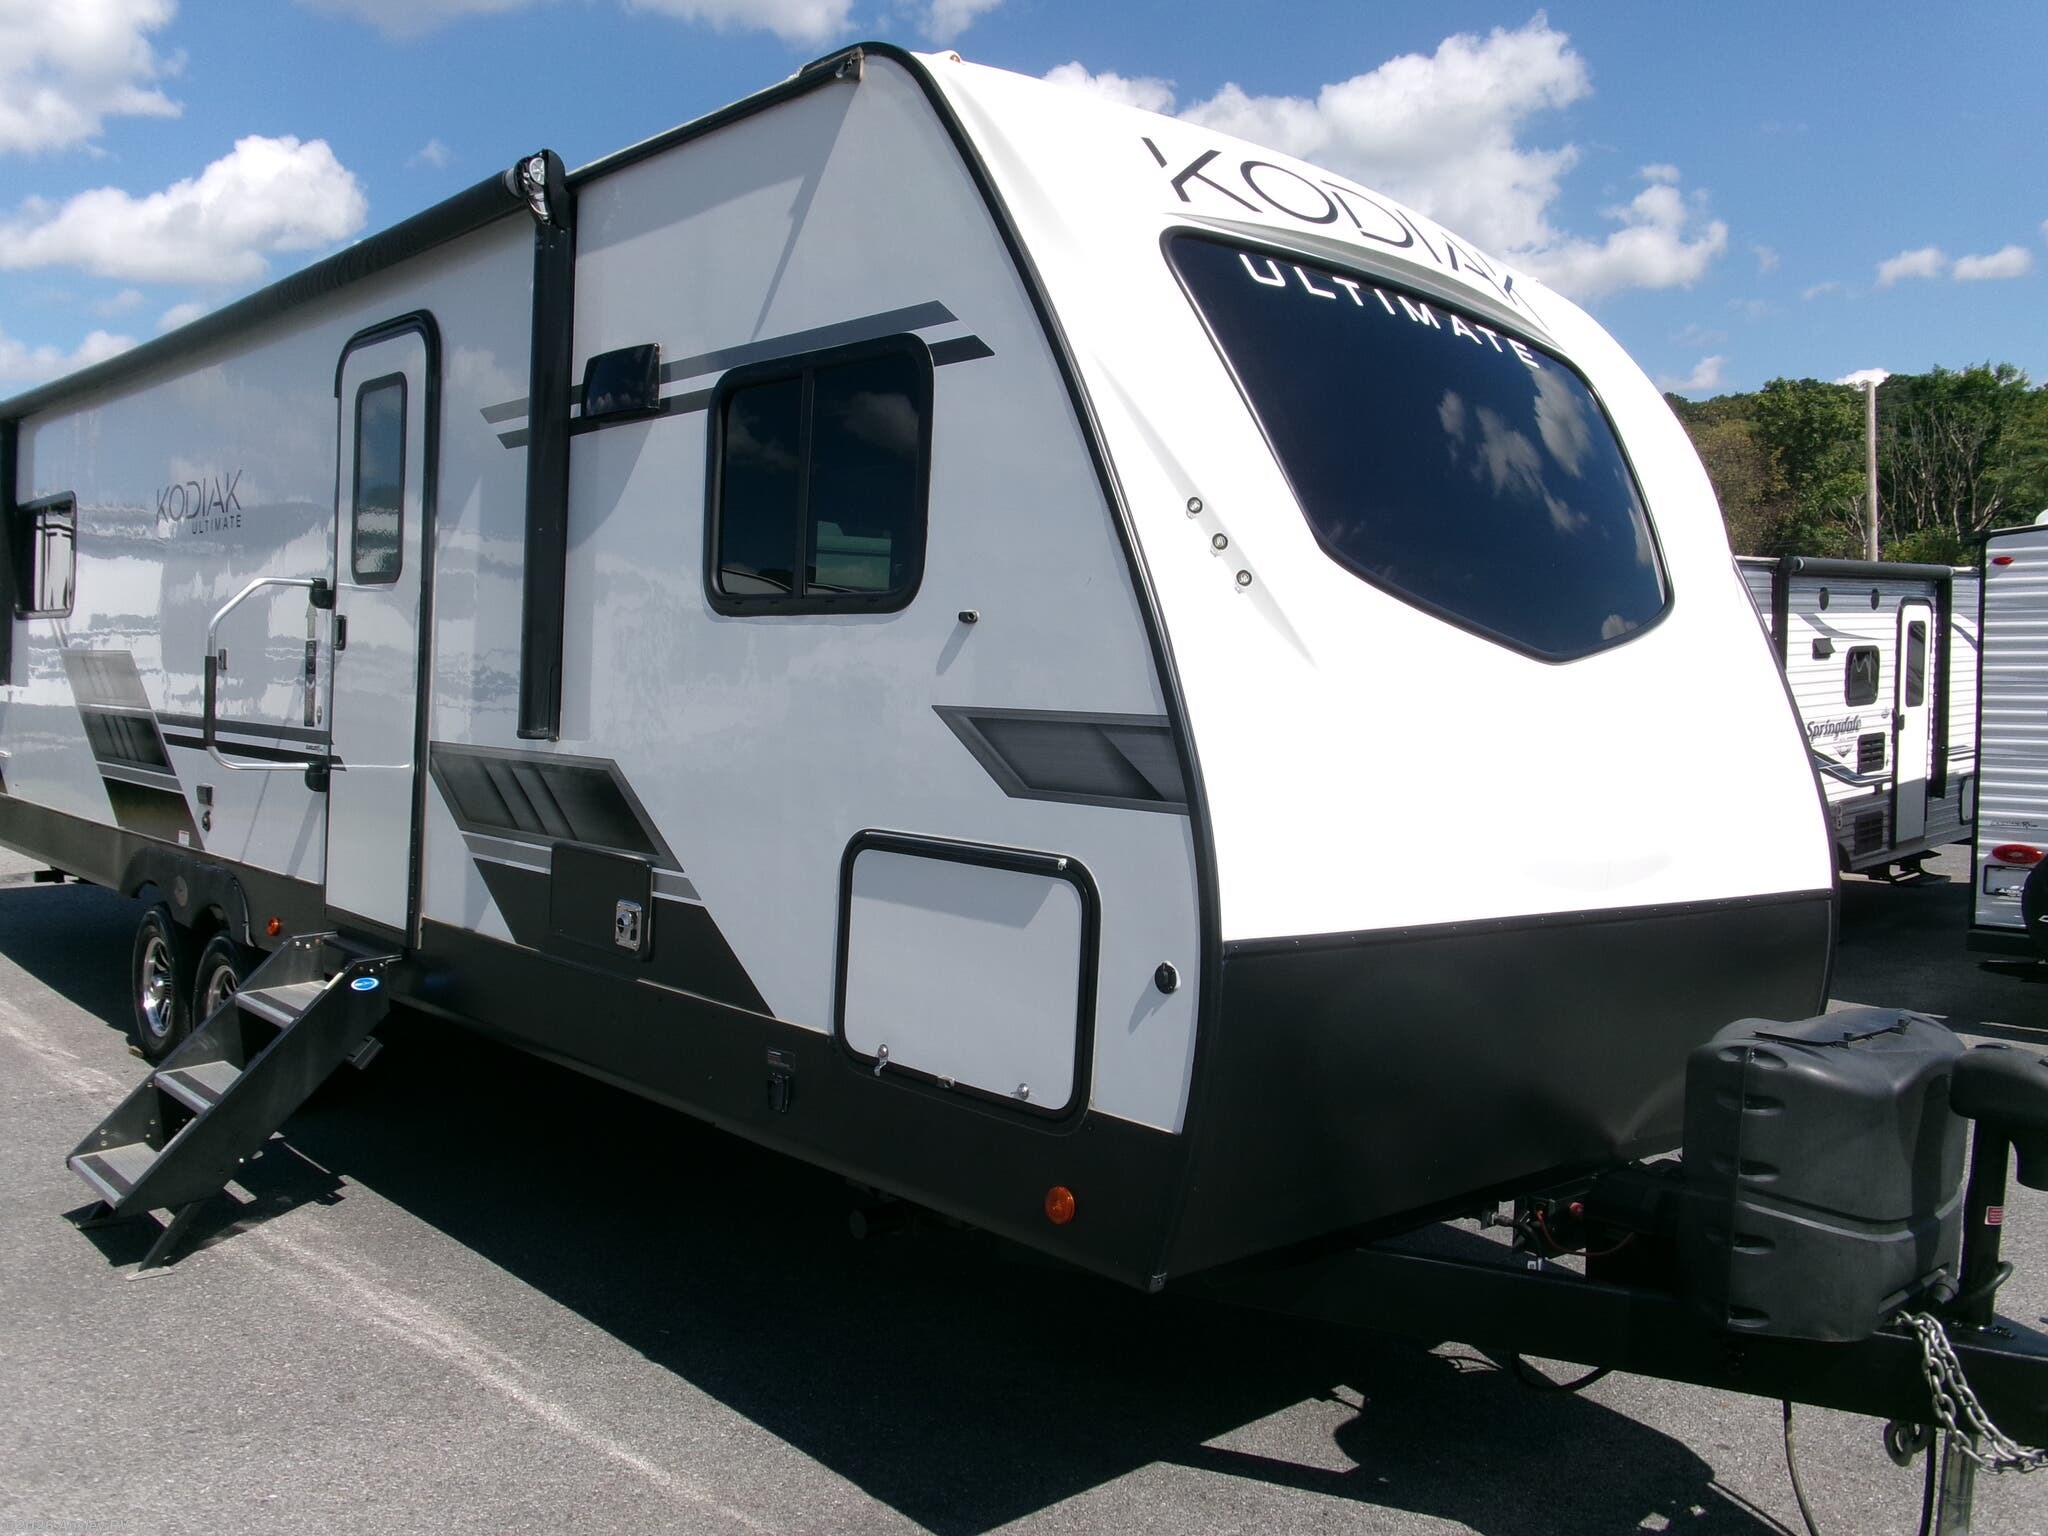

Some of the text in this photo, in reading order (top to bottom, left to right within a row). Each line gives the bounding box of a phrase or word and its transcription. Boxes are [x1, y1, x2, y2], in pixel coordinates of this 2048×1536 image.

[1141, 136, 1550, 331] KODIAK
[1239, 253, 1540, 369] ULTIMATE
[156, 469, 243, 525] KODIAK
[192, 514, 242, 534] ULTIMATE
[1807, 715, 1861, 741] Springdale
